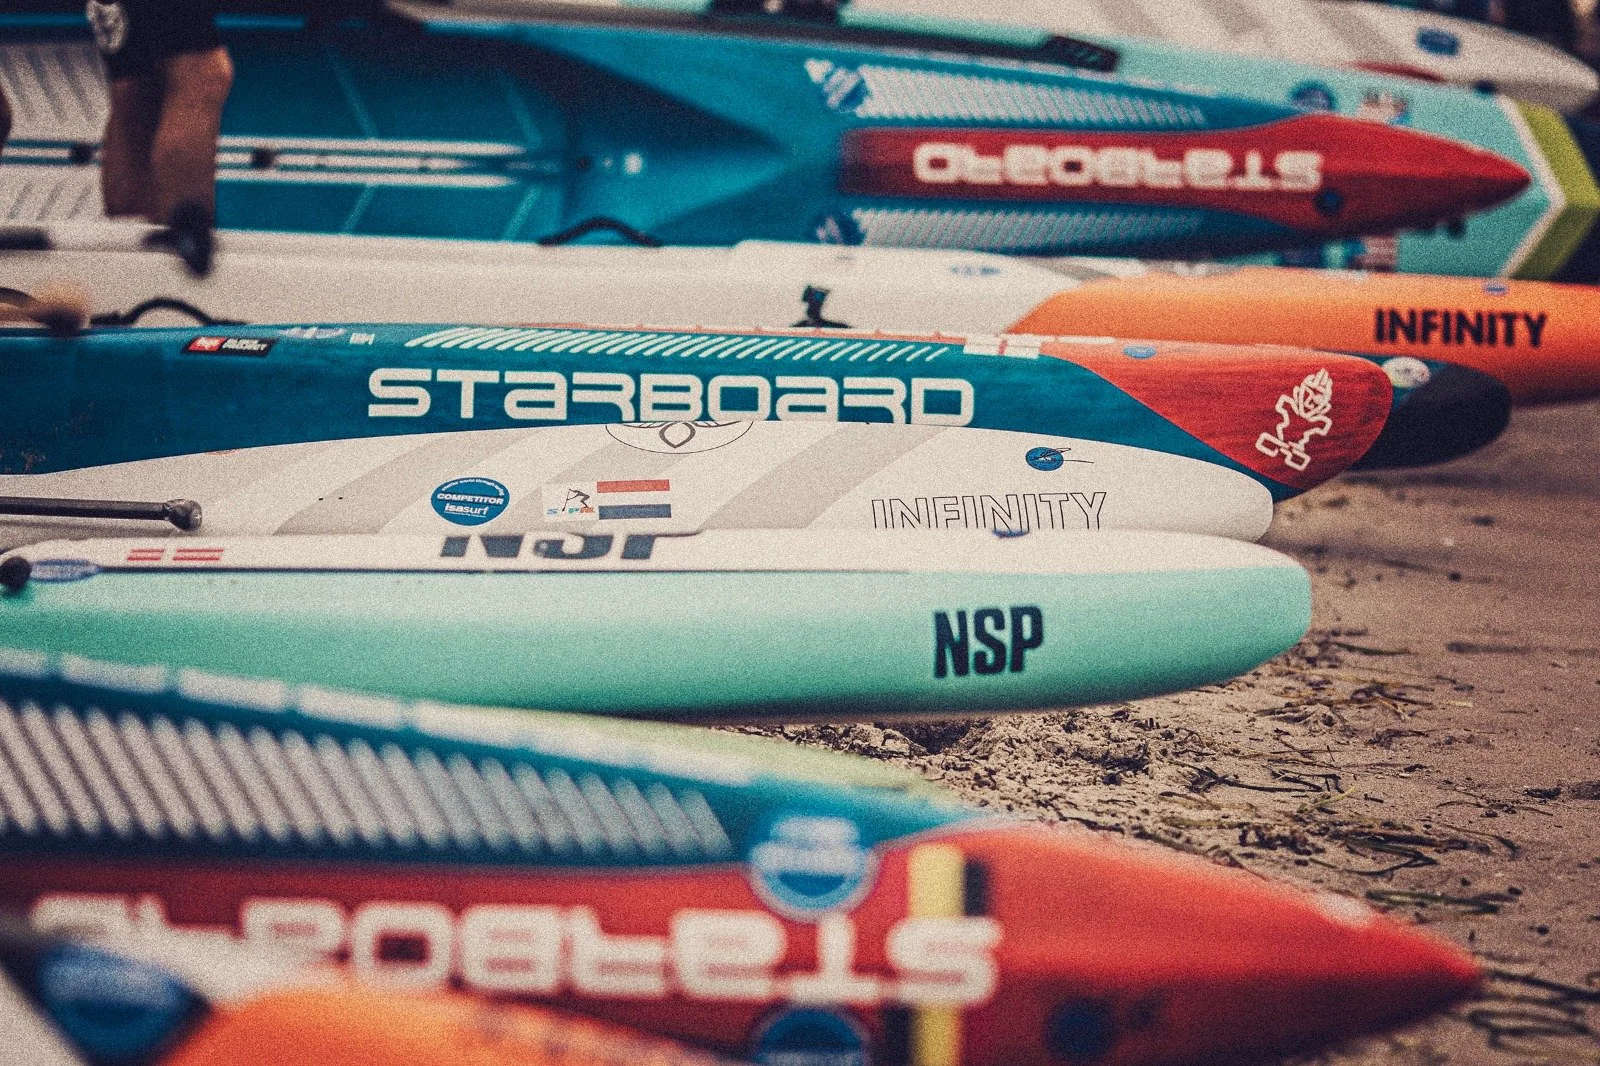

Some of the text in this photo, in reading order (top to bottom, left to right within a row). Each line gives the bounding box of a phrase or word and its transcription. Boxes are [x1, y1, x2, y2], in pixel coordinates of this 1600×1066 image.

[1374, 307, 1548, 349] INFINITY
[437, 493, 504, 505] COMPETITOR
[871, 491, 1107, 533] INFINITY
[934, 605, 1044, 679] NSP
